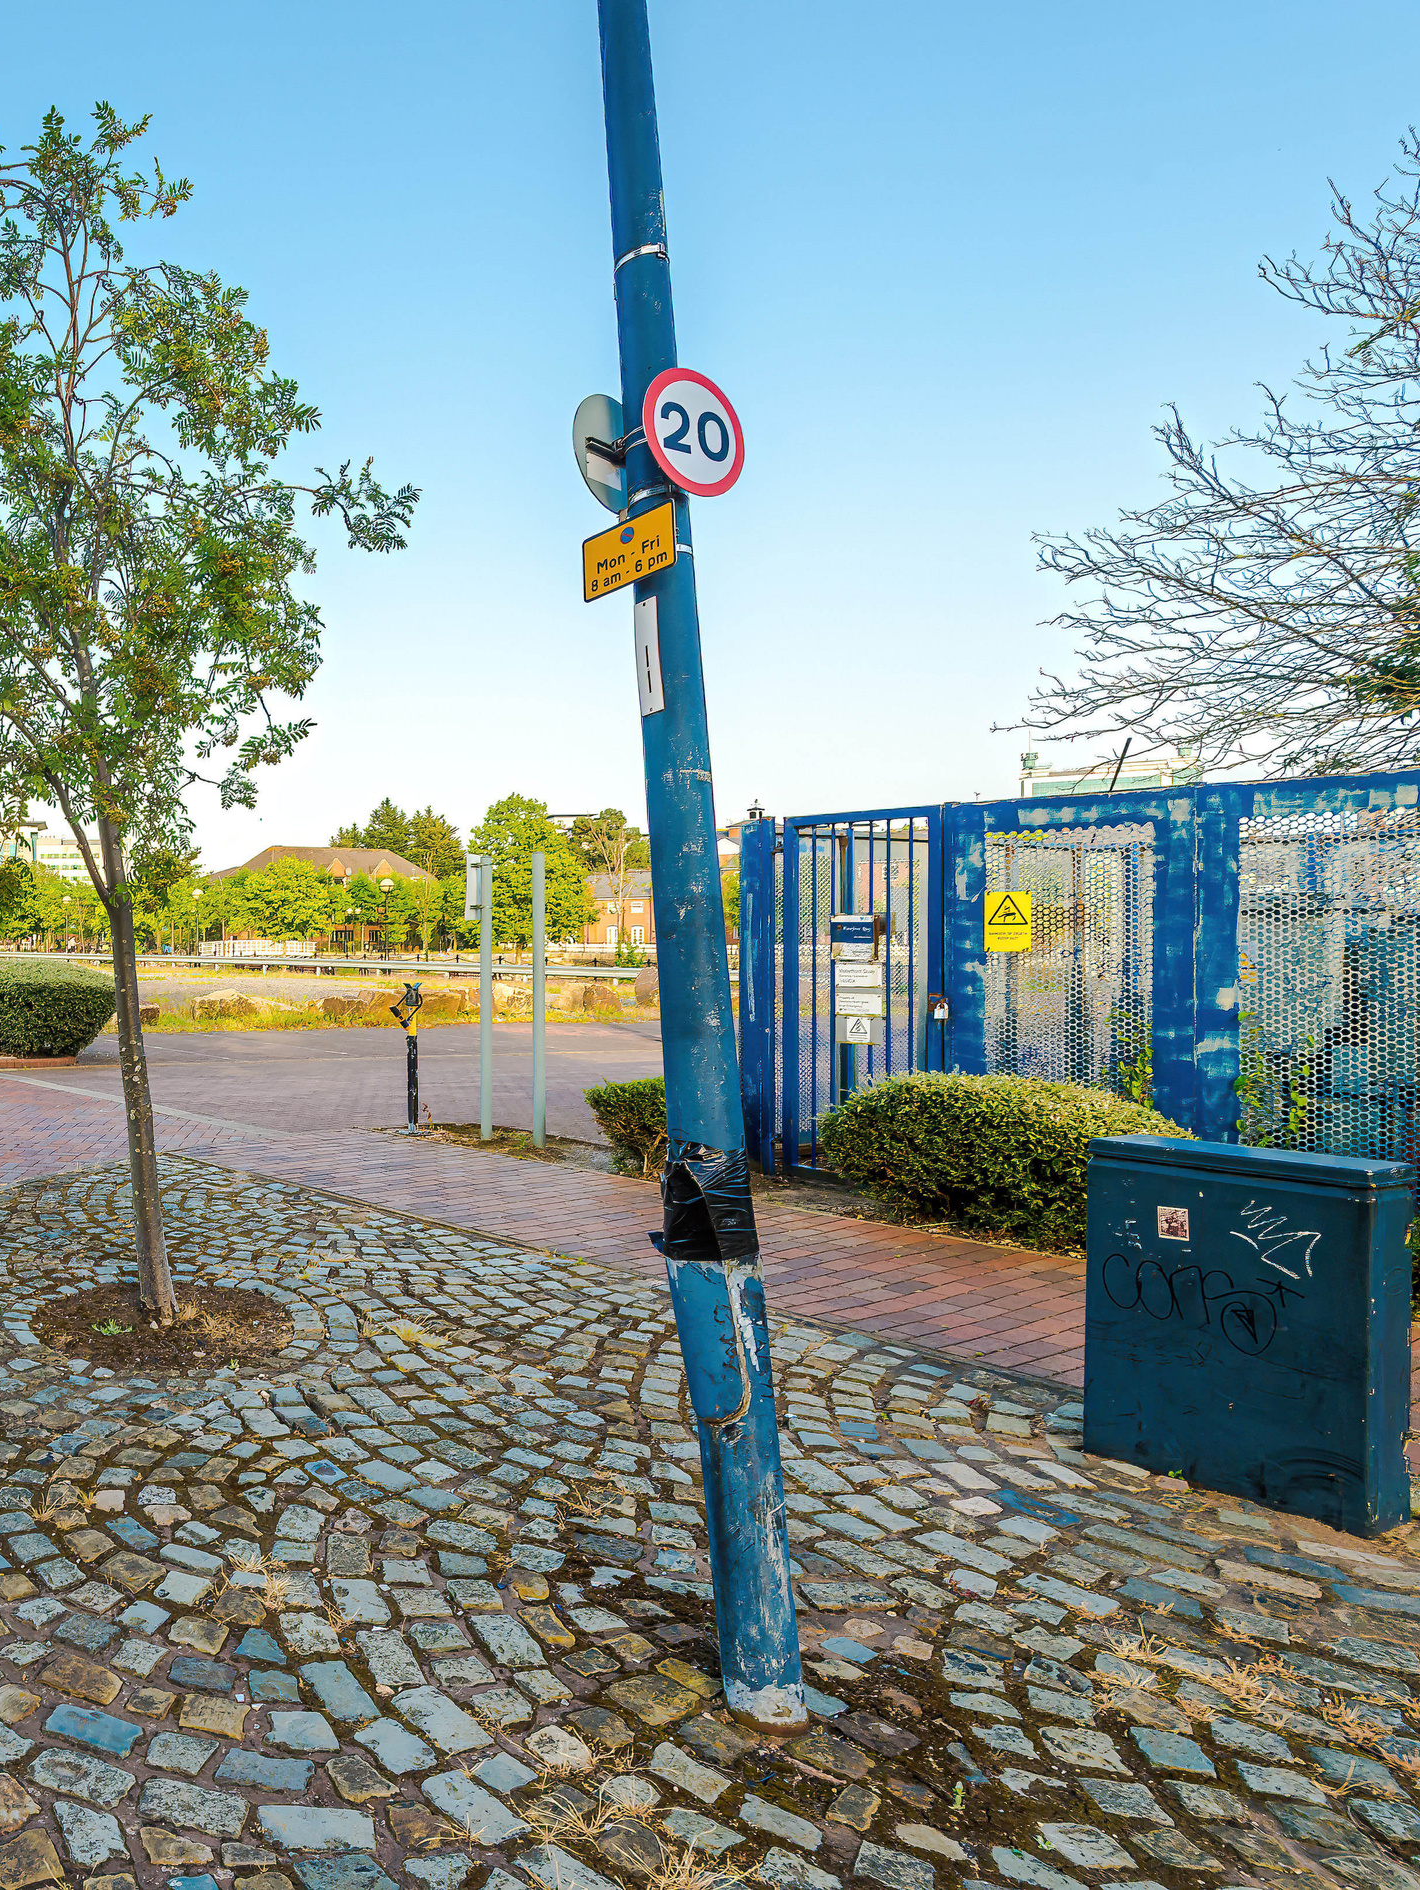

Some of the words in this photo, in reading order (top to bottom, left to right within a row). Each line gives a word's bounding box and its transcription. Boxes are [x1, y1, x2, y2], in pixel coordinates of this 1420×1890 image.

[660, 401, 730, 462] 20
[591, 579, 599, 592] 8
[603, 572, 621, 587] am
[634, 559, 643, 573] 6
[648, 551, 668, 570] pm
[597, 554, 626, 574] Mon
[641, 534, 660, 554] Fri
